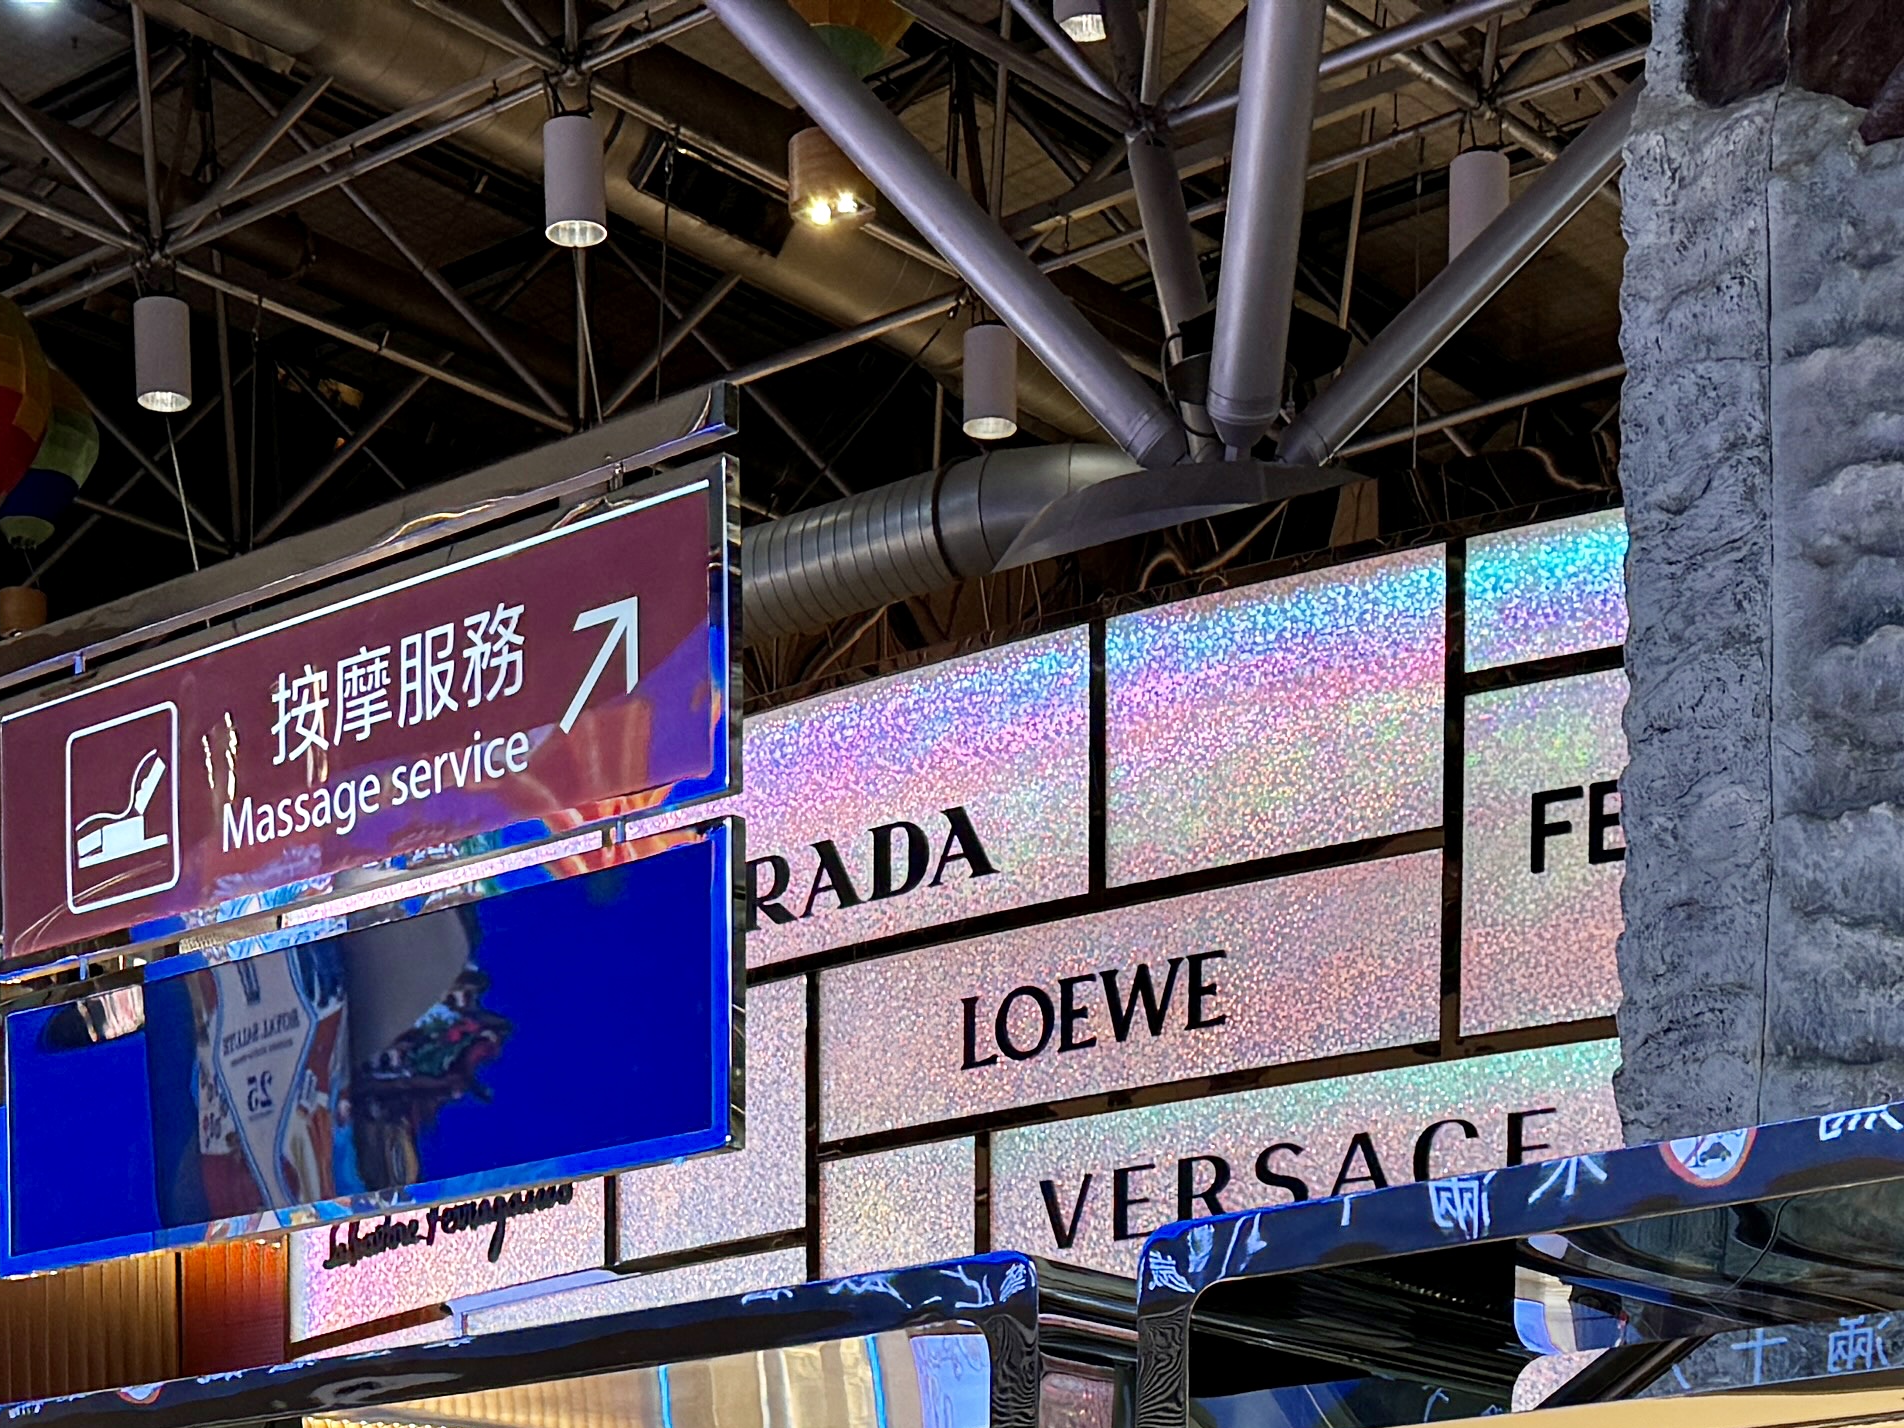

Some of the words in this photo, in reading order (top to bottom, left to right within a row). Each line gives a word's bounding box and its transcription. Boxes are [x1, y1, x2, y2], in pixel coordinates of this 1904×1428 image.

[270, 602, 527, 766] 按摩服務
[222, 777, 381, 853] Massage
[391, 730, 530, 806] service
[1530, 780, 1624, 873] FE
[745, 806, 999, 931] RADA
[961, 950, 1227, 1070] LOEWE
[1040, 1108, 1557, 1250] VERSACE
